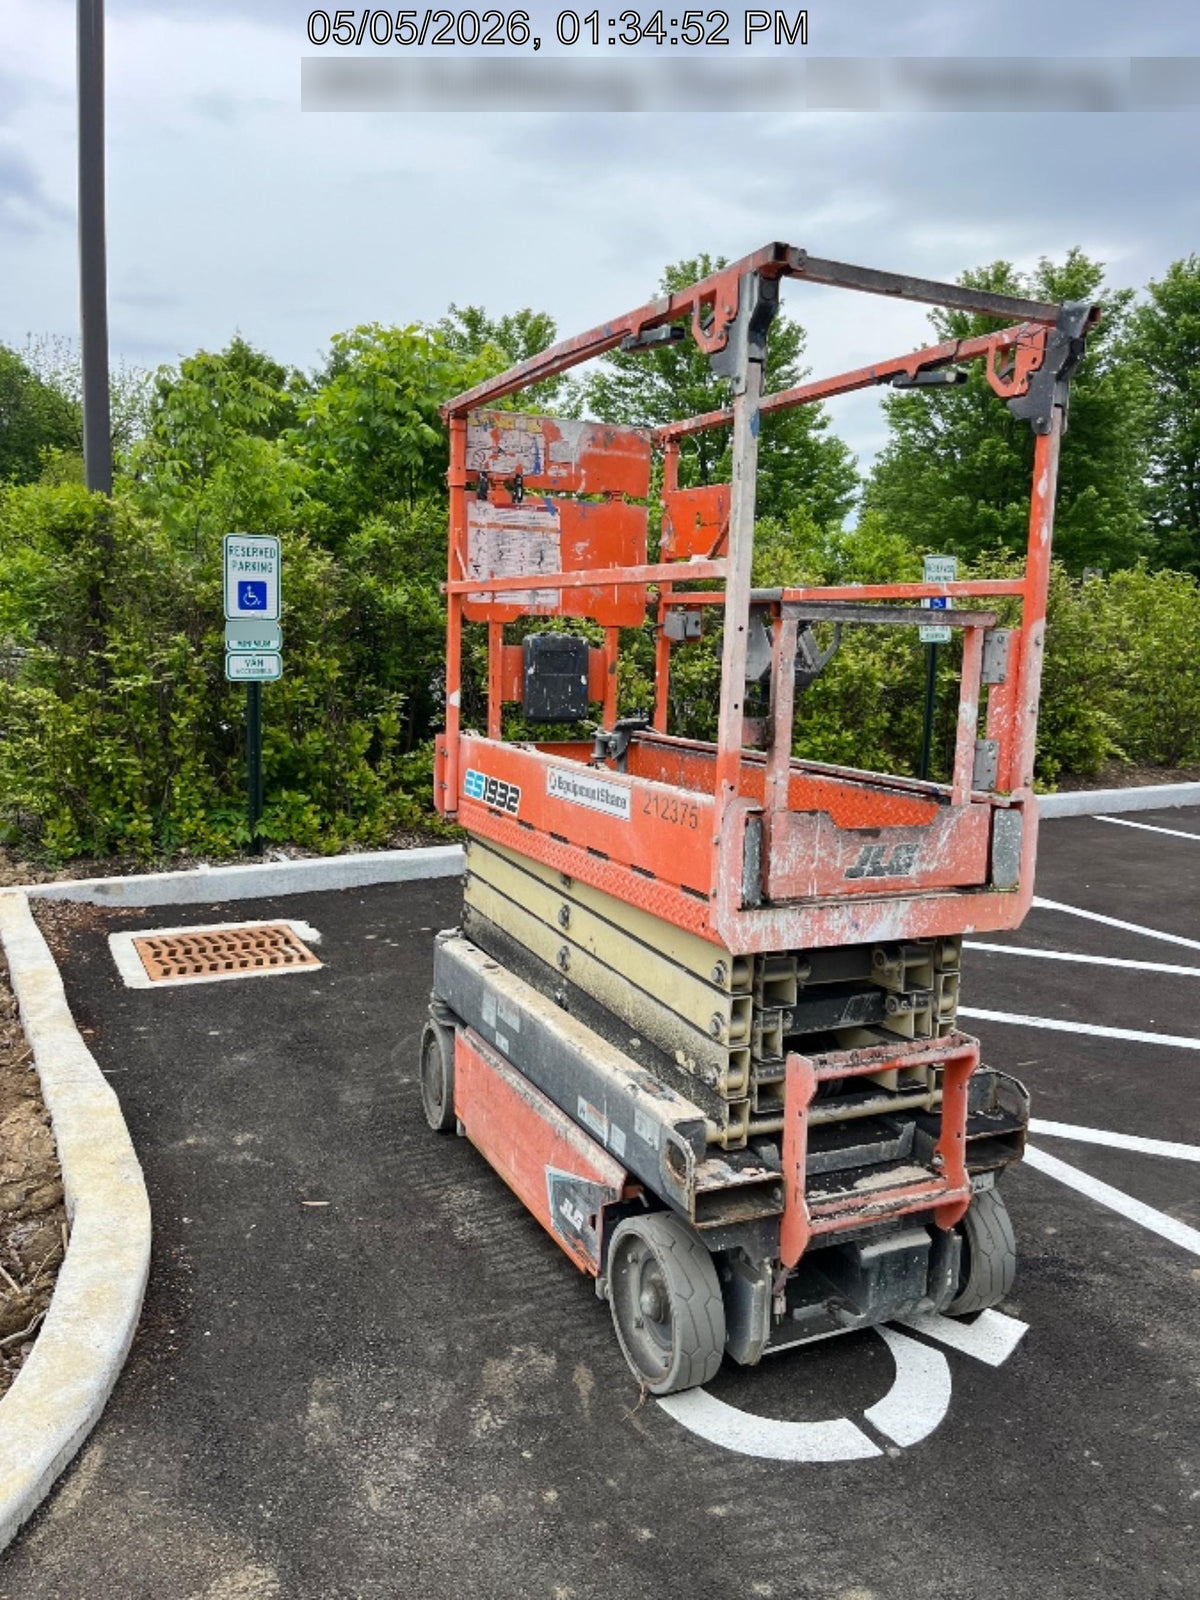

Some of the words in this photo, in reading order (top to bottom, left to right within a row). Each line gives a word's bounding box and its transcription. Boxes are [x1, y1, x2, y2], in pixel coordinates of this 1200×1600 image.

[228, 545, 276, 559] RESERVED
[231, 560, 273, 573] PARKING
[244, 659, 264, 668] VAN
[642, 791, 698, 830] 212375
